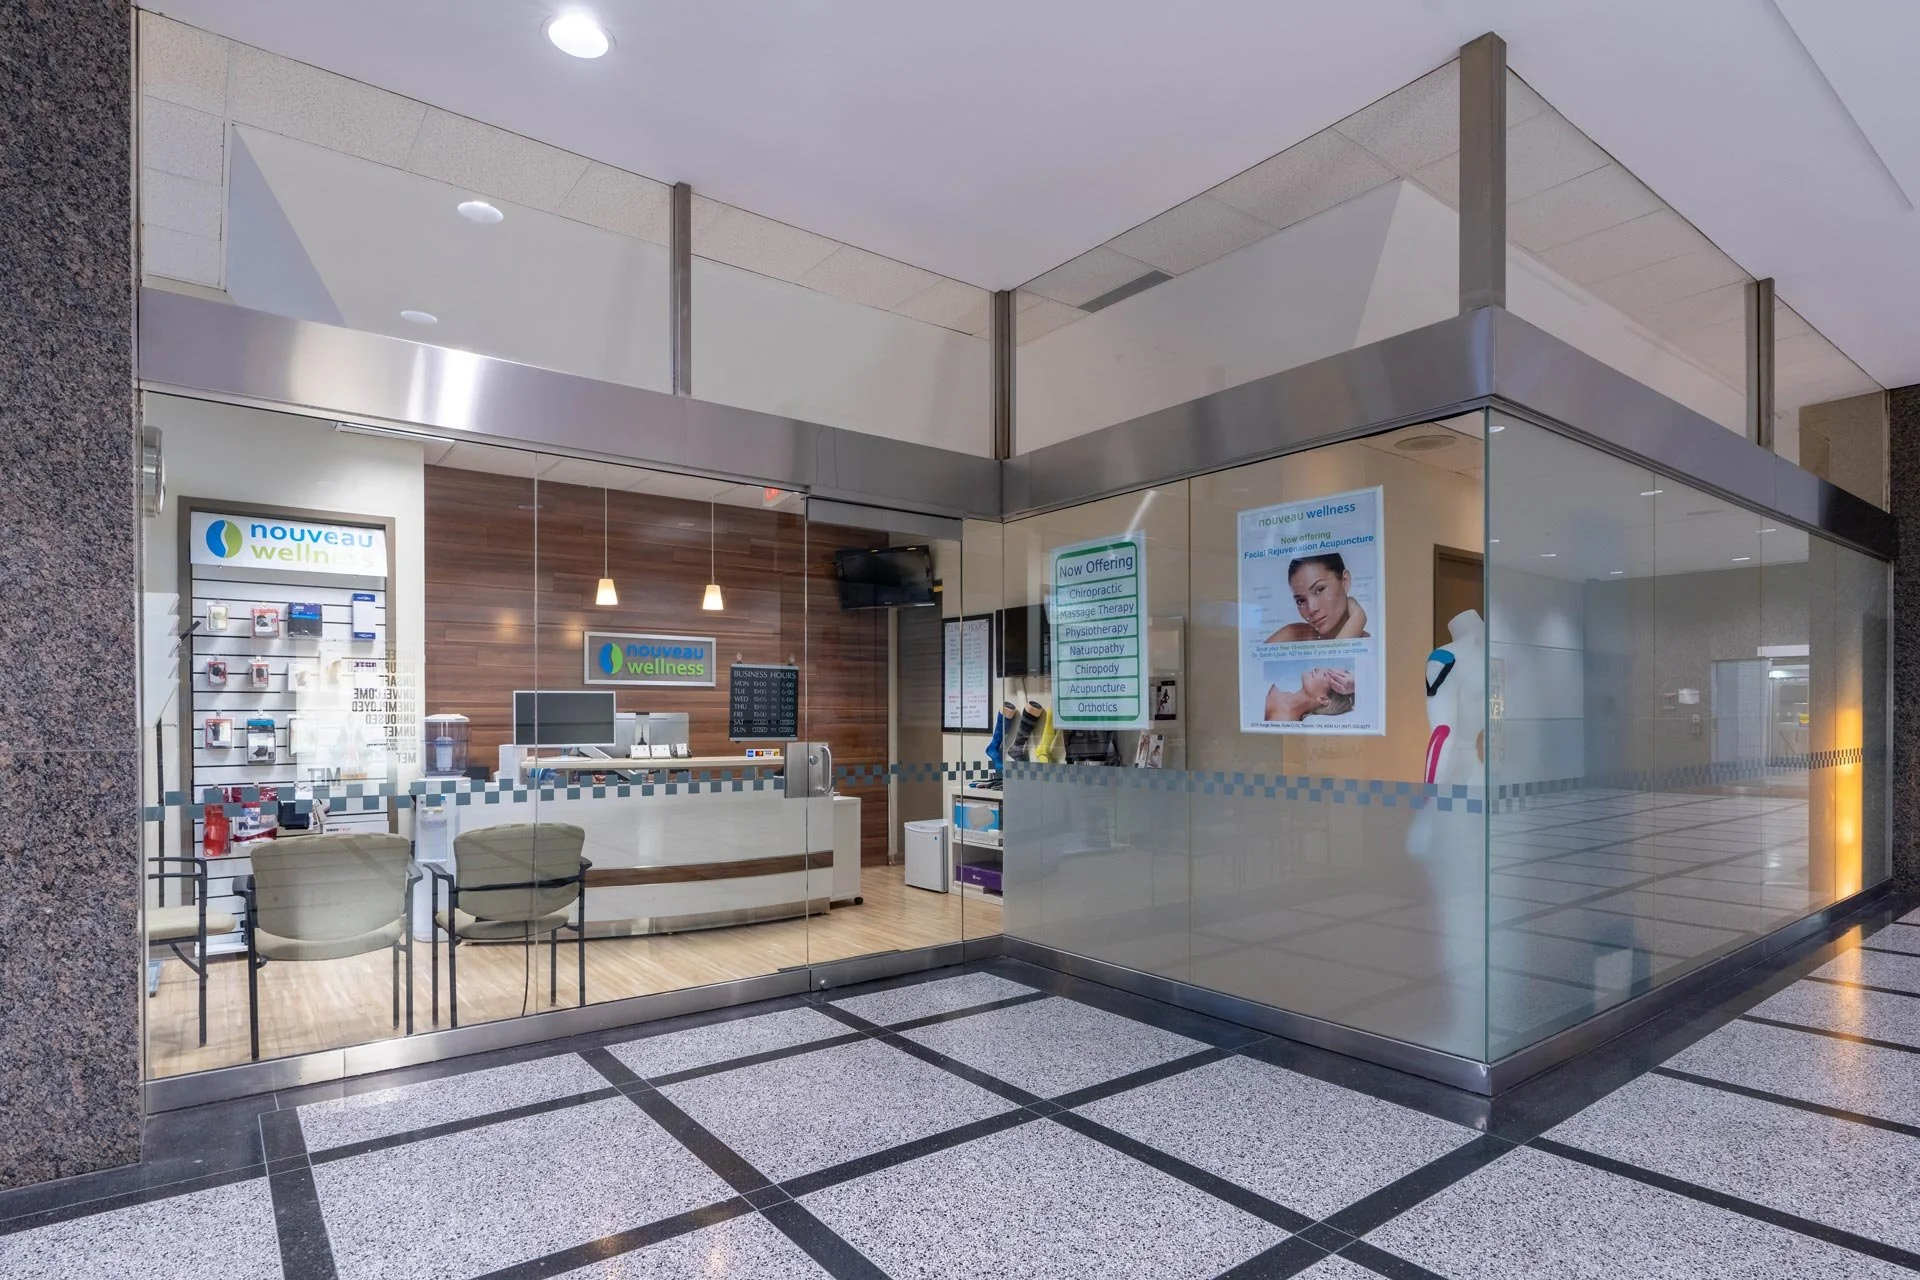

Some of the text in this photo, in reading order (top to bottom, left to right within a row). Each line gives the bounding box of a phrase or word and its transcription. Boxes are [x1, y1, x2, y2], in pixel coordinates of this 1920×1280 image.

[1258, 503, 1356, 527] nouveau wellness
[250, 523, 373, 548] nouveau
[1280, 531, 1331, 545] Now offering
[1244, 535, 1374, 559] Facial Rejuvenation Acupuncture
[250, 543, 376, 568] wellnes
[1059, 555, 1134, 579] Now Offering
[1069, 583, 1123, 599] Chiropractic
[1060, 602, 1135, 620] Massage Therapy
[1065, 623, 1129, 638] Physiotherapy
[626, 644, 705, 660] nouveau
[1070, 642, 1125, 656] Naturopathy
[627, 658, 705, 676] wellness
[734, 670, 797, 680] BUSINESS HOURS
[1075, 663, 1120, 676] Chiropody
[1069, 682, 1126, 695] Acupuncture
[1078, 702, 1118, 713] Orthotics
